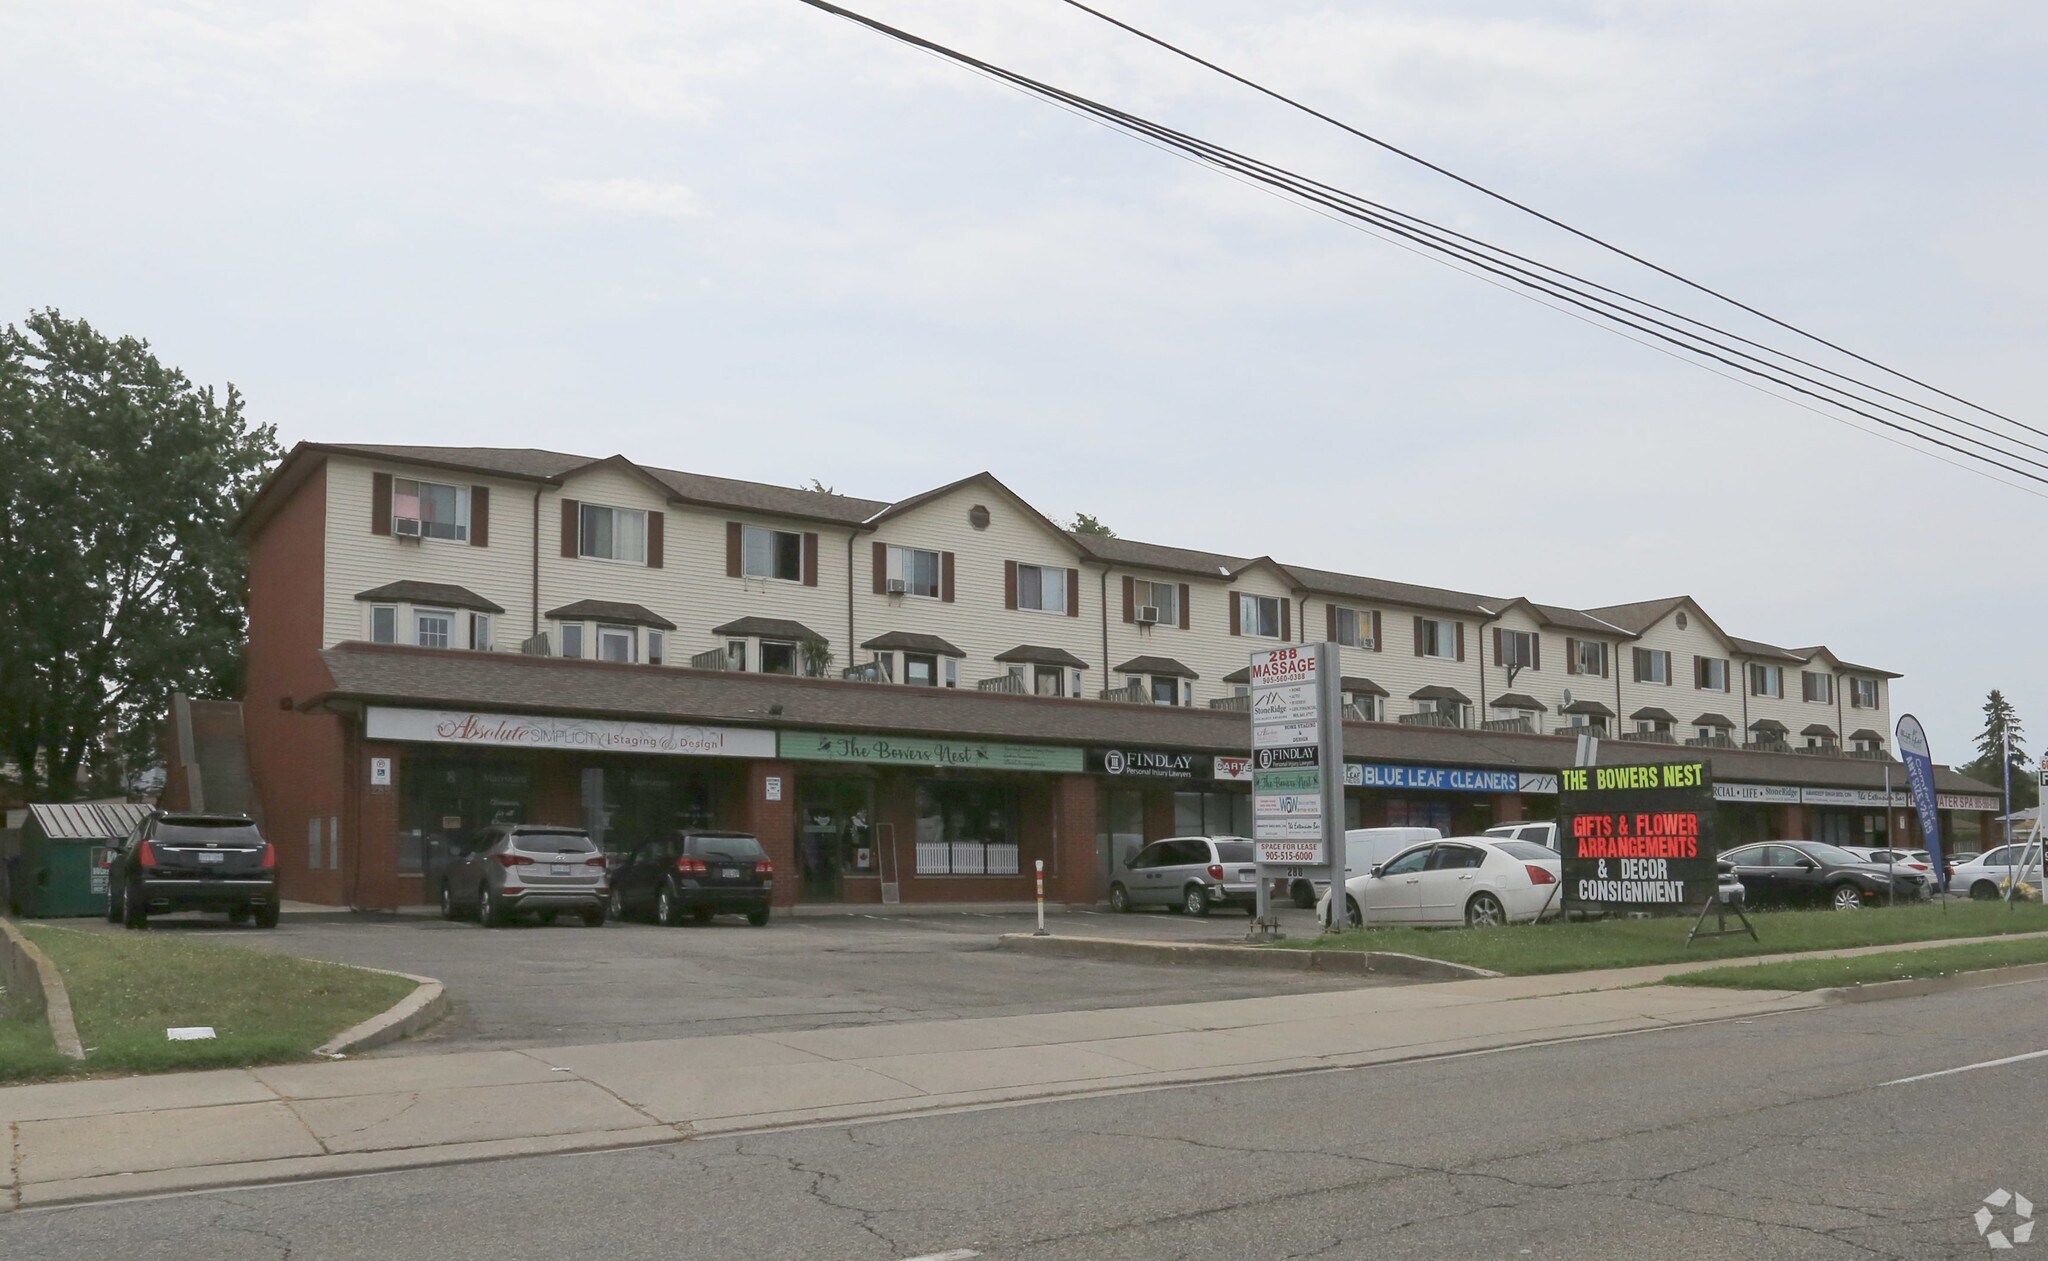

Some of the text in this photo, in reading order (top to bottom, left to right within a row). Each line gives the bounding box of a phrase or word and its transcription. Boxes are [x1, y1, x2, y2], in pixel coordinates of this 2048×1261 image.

[1269, 648, 1297, 662] 288
[1253, 658, 1315, 678] MASSAGE
[1255, 704, 1287, 715] StoneRidge
[437, 714, 530, 742] Absolute
[530, 728, 604, 748] SIMPLICITY
[613, 734, 657, 748] Staging
[680, 737, 718, 749] Design
[837, 738, 972, 763] The Bowers Nest
[1273, 747, 1314, 760] FINDLAY
[1127, 752, 1192, 769] FINDLAY
[1126, 767, 1192, 778] Personal Injury Lawyers
[1364, 767, 1404, 786] BLUE
[1408, 769, 1445, 788] LEAF
[1450, 771, 1518, 790] CLEANERS
[1562, 764, 1702, 790] THE BOWERS NEST
[1905, 756, 1917, 776] ANY
[1912, 780, 1924, 802] SIZE
[1742, 788, 1758, 798] LIFE
[1765, 787, 1798, 798] StoneRidge
[1960, 797, 1973, 808] SPA
[1574, 814, 1698, 836] GIFTS & FLOWER
[1261, 843, 1281, 851] SPACE
[1266, 851, 1313, 861] 905-515-6000
[1578, 836, 1697, 858] ARRANGEMENTS
[1287, 867, 1303, 877] 288
[1598, 858, 1667, 880] & DECOR
[1578, 879, 1684, 902] CONSIGNMENT
